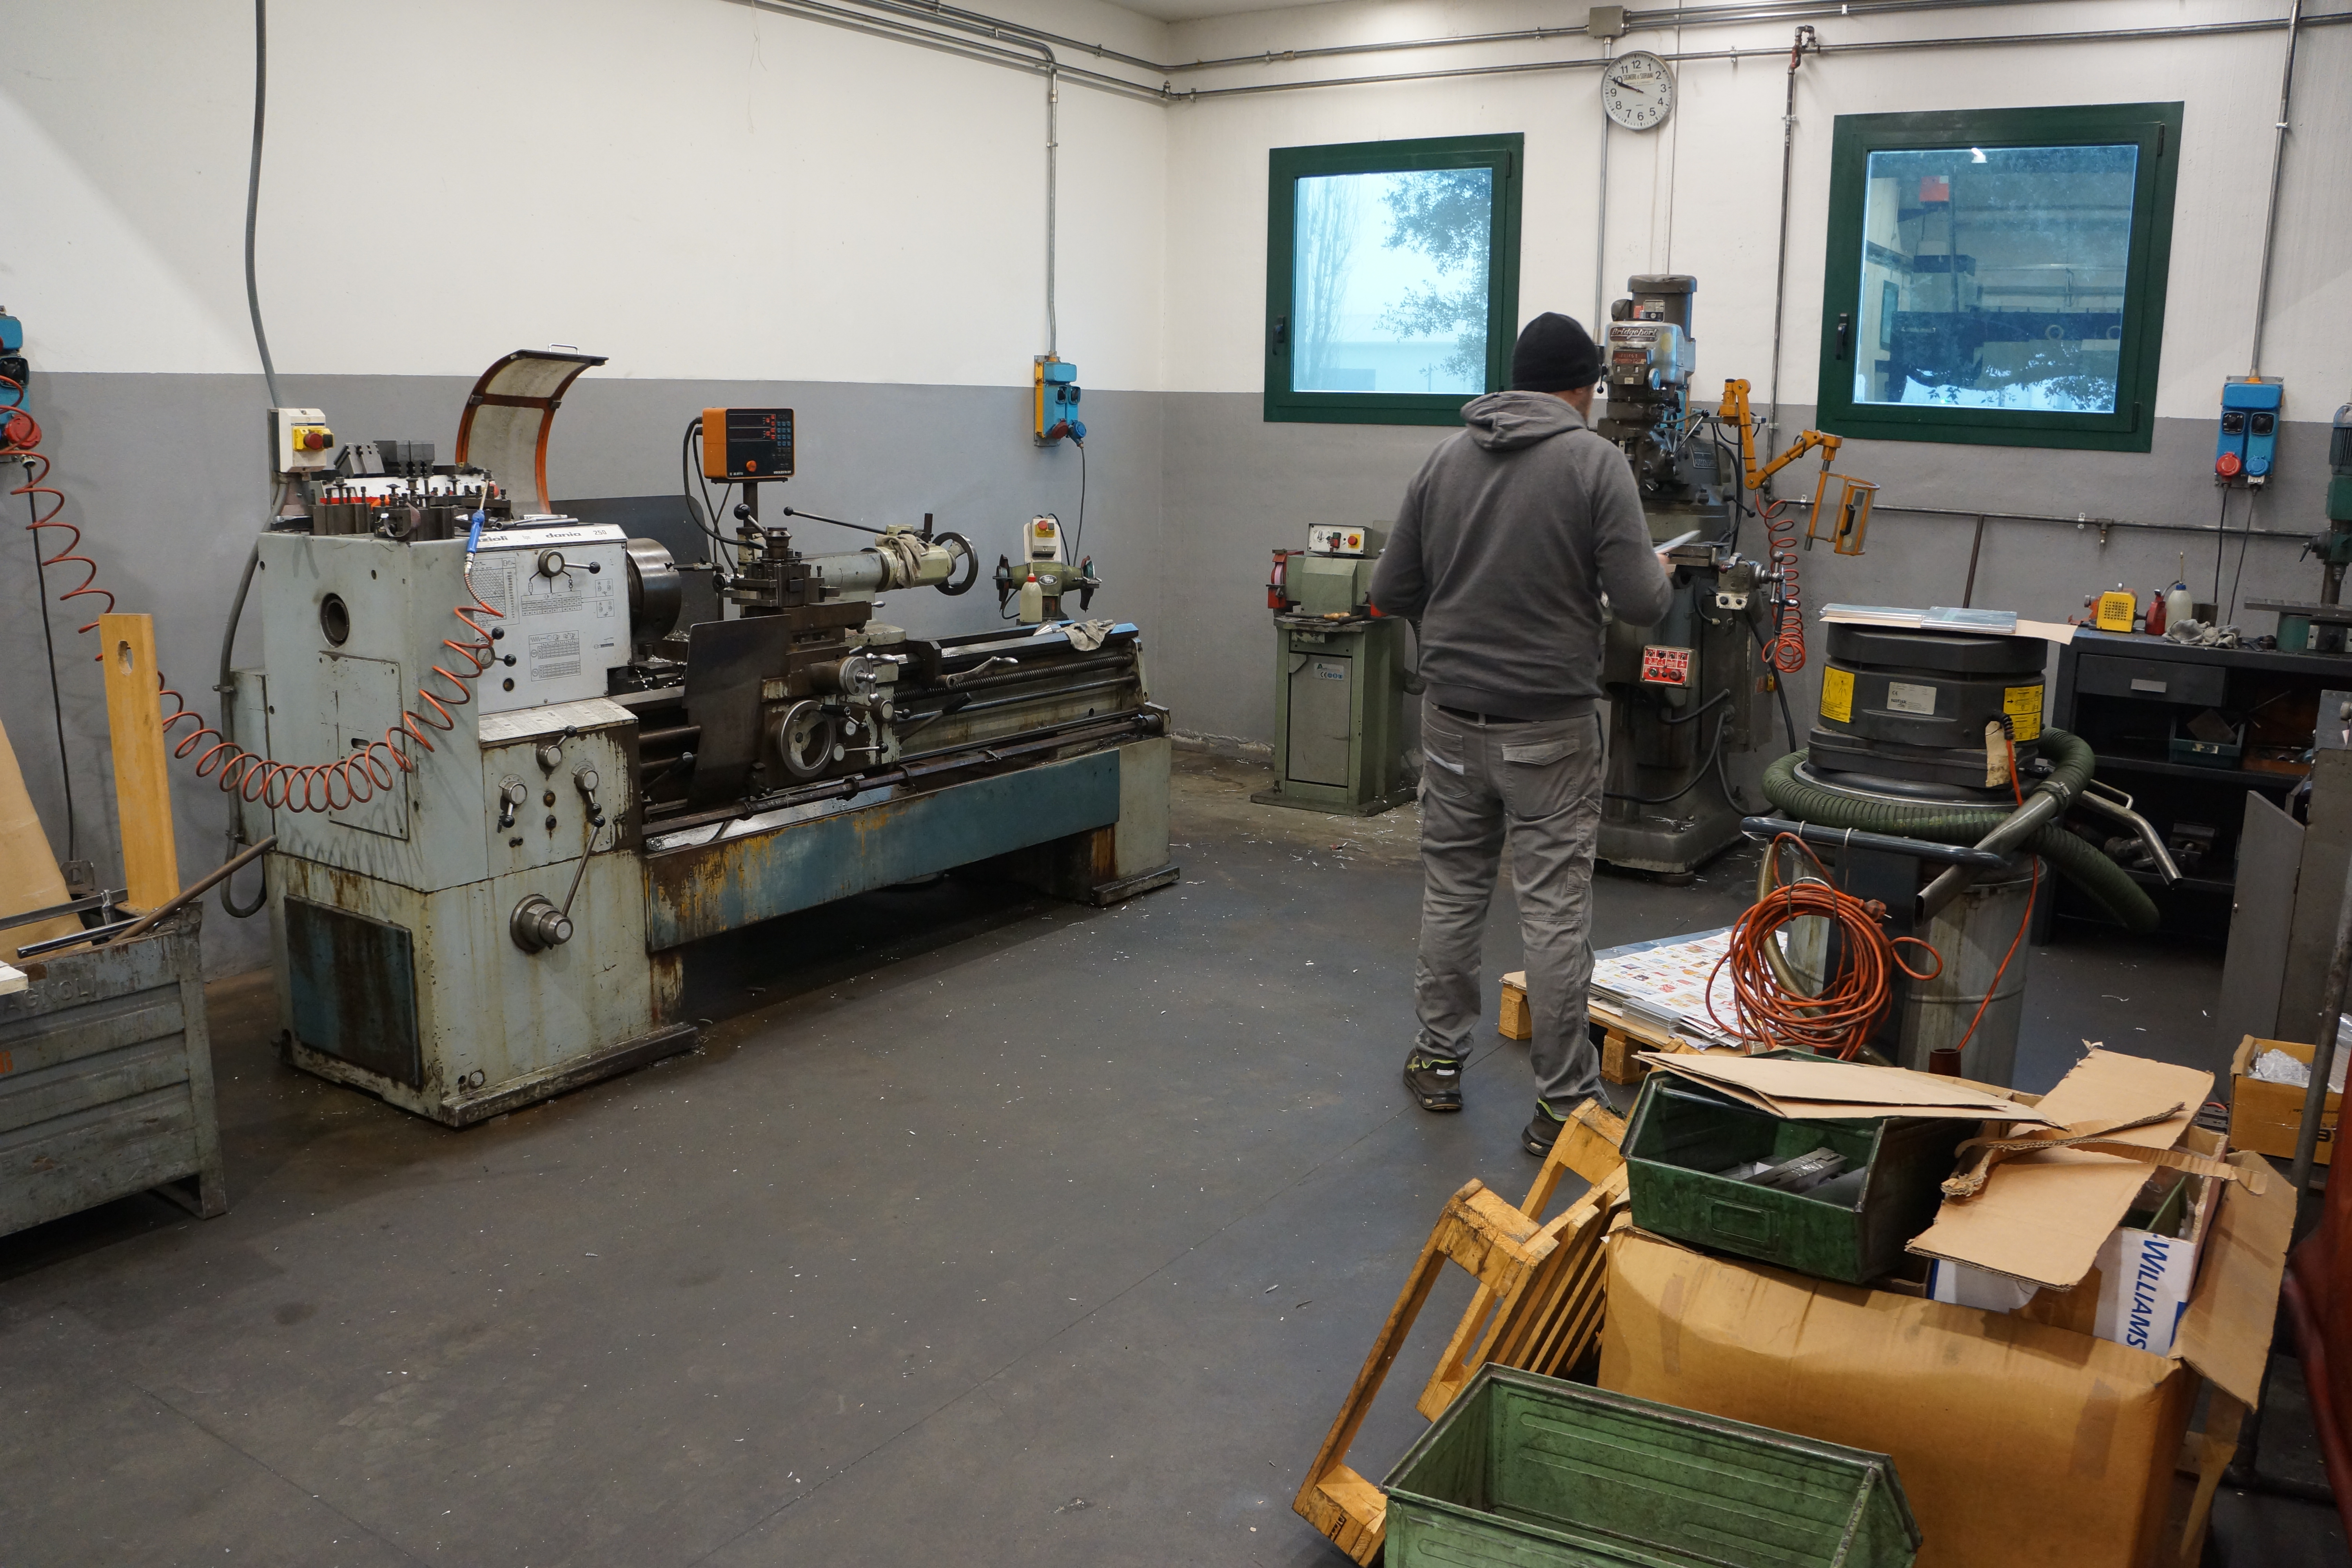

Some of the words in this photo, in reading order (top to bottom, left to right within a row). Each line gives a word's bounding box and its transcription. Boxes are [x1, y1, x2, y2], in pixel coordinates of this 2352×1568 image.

[1632, 60, 1641, 69] 12
[1647, 63, 1651, 71] 1
[1620, 65, 1628, 74] 11
[1612, 76, 1623, 84] 10
[1655, 71, 1662, 80] 2
[1610, 88, 1617, 97] 9
[1660, 84, 1666, 93] 3
[1615, 101, 1622, 110] 8
[1657, 97, 1664, 106] 4
[1625, 109, 1632, 118] 7
[1649, 107, 1656, 116] 5
[1637, 112, 1644, 121] 6
[1611, 327, 1658, 340] Bridgeport
[2126, 1240, 2170, 1350] WILLIAMS
